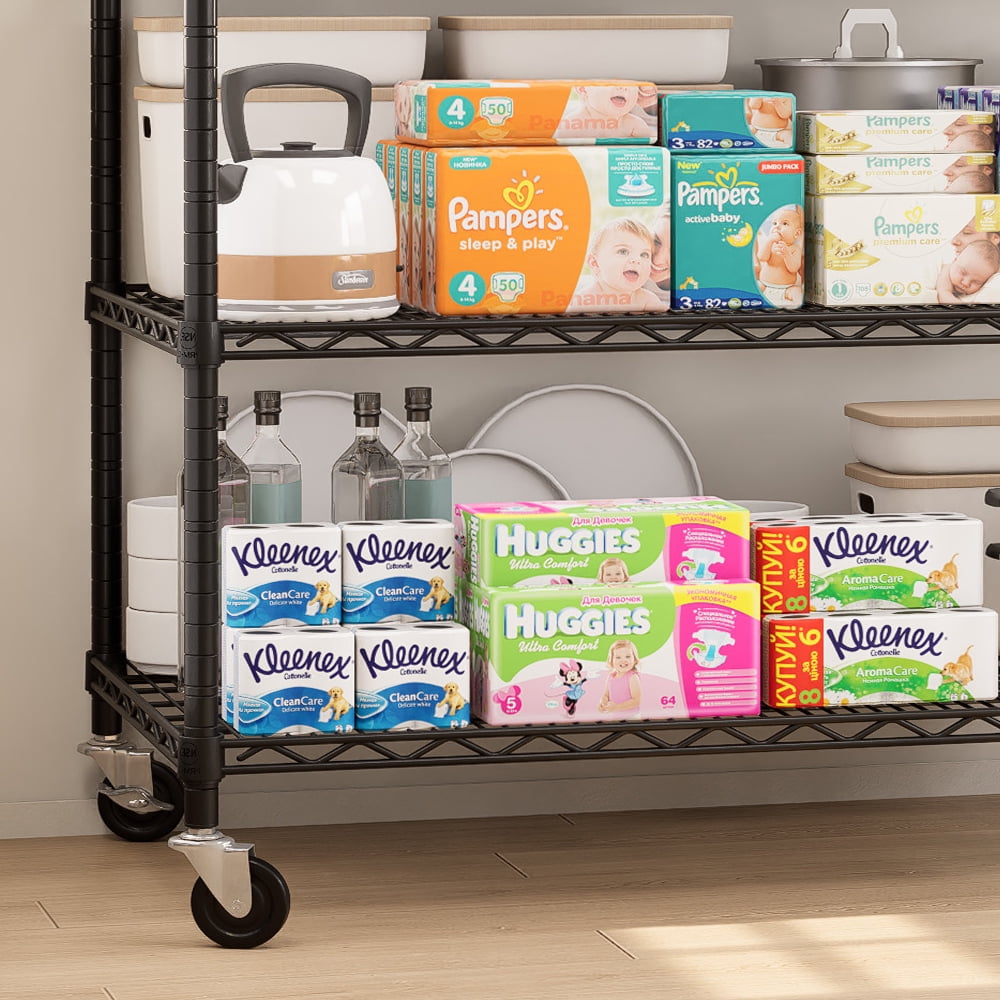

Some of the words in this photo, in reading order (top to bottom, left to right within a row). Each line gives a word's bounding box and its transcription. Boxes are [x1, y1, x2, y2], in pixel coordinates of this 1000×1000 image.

[446, 98, 466, 120] 4
[487, 103, 506, 115] 50
[529, 114, 620, 132] Panama
[865, 115, 931, 128] Pampers
[671, 137, 685, 149] 3
[697, 139, 713, 149] 82
[677, 161, 700, 170] New
[761, 163, 782, 171] JUMBO
[865, 156, 931, 170] Pampers
[865, 169, 909, 177] premium
[677, 181, 760, 213] Pampers
[448, 196, 565, 236] Pampers
[873, 215, 940, 238] Pampers
[459, 237, 502, 252] sleep
[506, 237, 518, 250] &
[873, 238, 917, 247] premium
[457, 273, 478, 297] 4
[500, 279, 518, 291] 50
[540, 290, 632, 307] Panama
[679, 296, 693, 309] 3
[705, 298, 721, 309] 82
[571, 516, 590, 526] Для
[593, 515, 632, 526] Девочек
[494, 523, 640, 557] HUGGIES
[785, 534, 808, 553] 6
[813, 526, 929, 568] Kleenex
[231, 537, 338, 576] Kleenex
[346, 533, 452, 573] Kleenex
[509, 558, 540, 570] Ultra
[543, 557, 589, 572] Comfort
[757, 531, 784, 613] КУПУЙ!
[789, 568, 797, 580] за
[581, 595, 600, 605] Для
[602, 594, 643, 605] Девочек
[785, 595, 808, 611] 8
[503, 603, 651, 639] HUGGIES
[799, 627, 822, 646] 6
[826, 618, 944, 660] Kleenex
[518, 641, 549, 653] Ultra
[552, 639, 600, 653] Comfort
[243, 643, 352, 684] Kleenex
[359, 639, 467, 679] Kleenex
[770, 624, 797, 707] КУПУЙ!
[802, 661, 810, 673] за
[506, 696, 517, 709] 5
[660, 696, 676, 706] 64
[799, 688, 822, 705] 8
